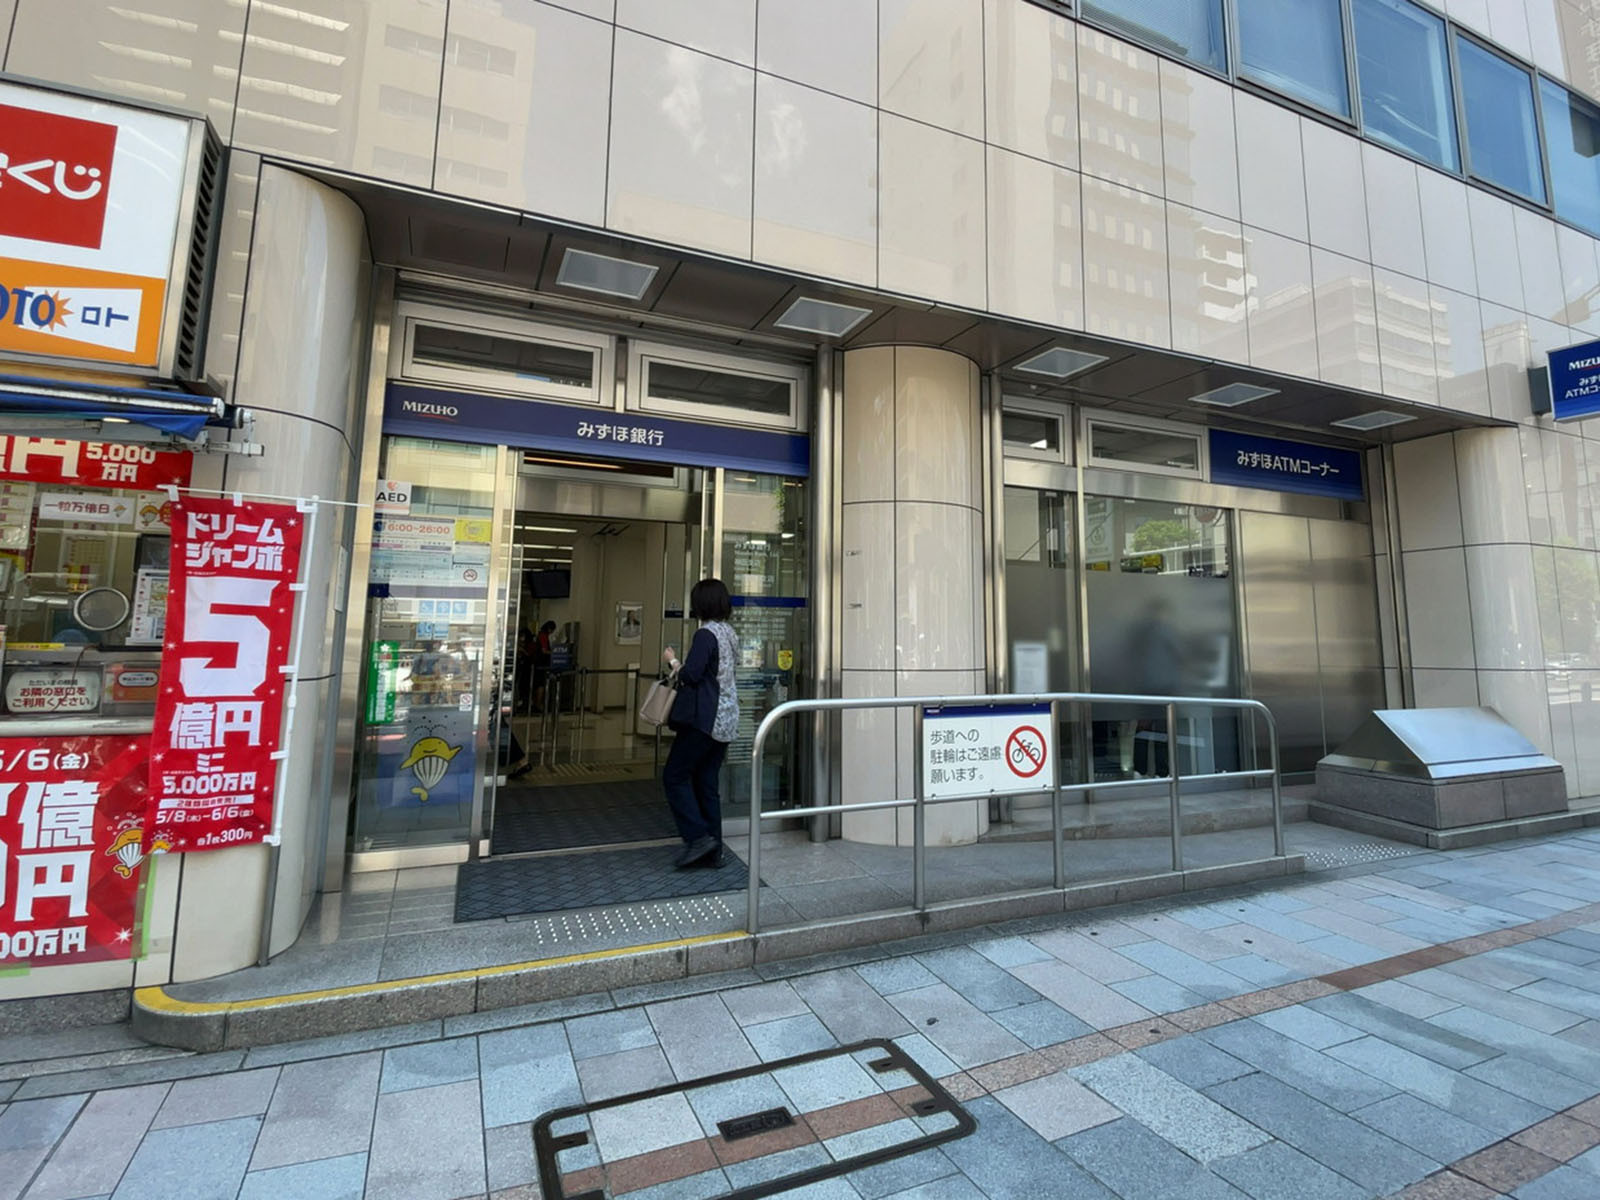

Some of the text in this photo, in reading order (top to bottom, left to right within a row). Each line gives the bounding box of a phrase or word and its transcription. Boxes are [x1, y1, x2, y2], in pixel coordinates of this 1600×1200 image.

[0, 152, 102, 200] くじ
[81, 305, 129, 328] ロト
[1565, 385, 1600, 400] ATMコ
[1578, 375, 1600, 387] みず
[402, 400, 458, 417] MIZUHO
[577, 420, 665, 447] みずほ銀行
[0, 435, 80, 478] 円
[1236, 449, 1340, 477] みずほATMコーナー
[101, 462, 139, 482] 万円
[375, 491, 408, 503] AED
[186, 511, 285, 545] ドリーム
[185, 541, 285, 572] ジャンボ
[179, 575, 281, 698] 5
[168, 701, 265, 750] 億円
[930, 729, 980, 745] 歩道への
[0, 748, 90, 773] /6(金)
[196, 753, 226, 774] ミニ
[930, 746, 1002, 765] 駐輪はご遠慮
[930, 767, 985, 784] 願います。
